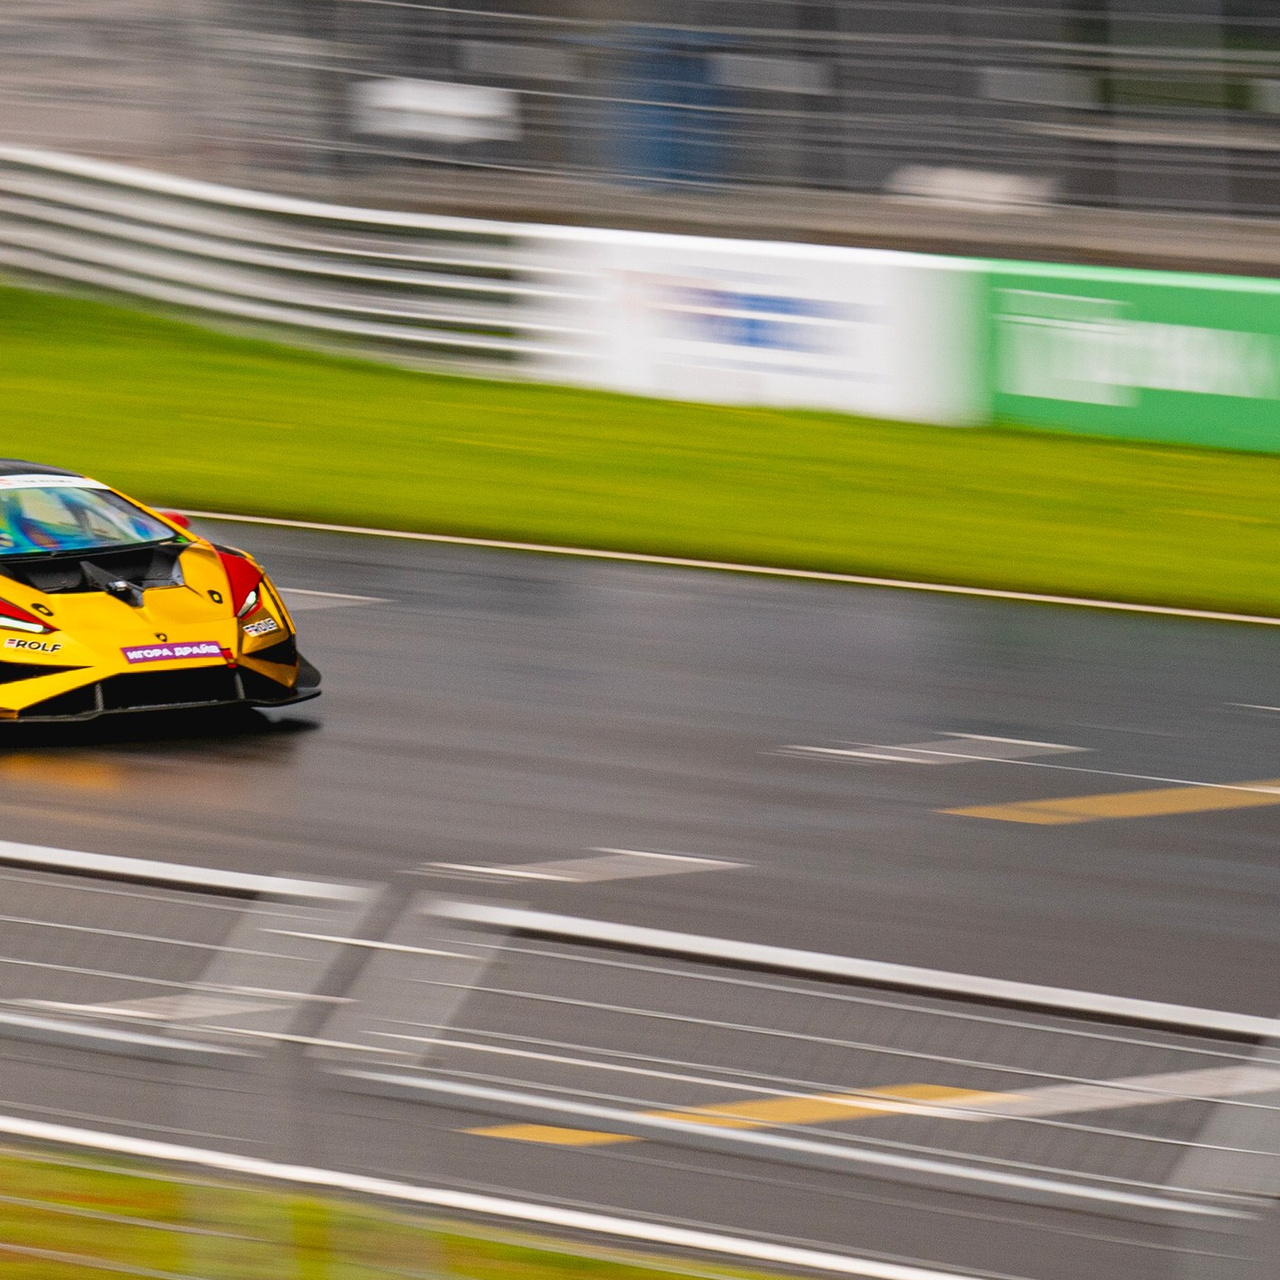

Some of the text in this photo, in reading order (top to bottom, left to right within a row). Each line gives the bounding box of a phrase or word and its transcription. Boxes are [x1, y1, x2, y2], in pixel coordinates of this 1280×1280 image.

[15, 639, 62, 653] ROLF
[126, 643, 221, 660] ИГОРА ДРАЙВ
